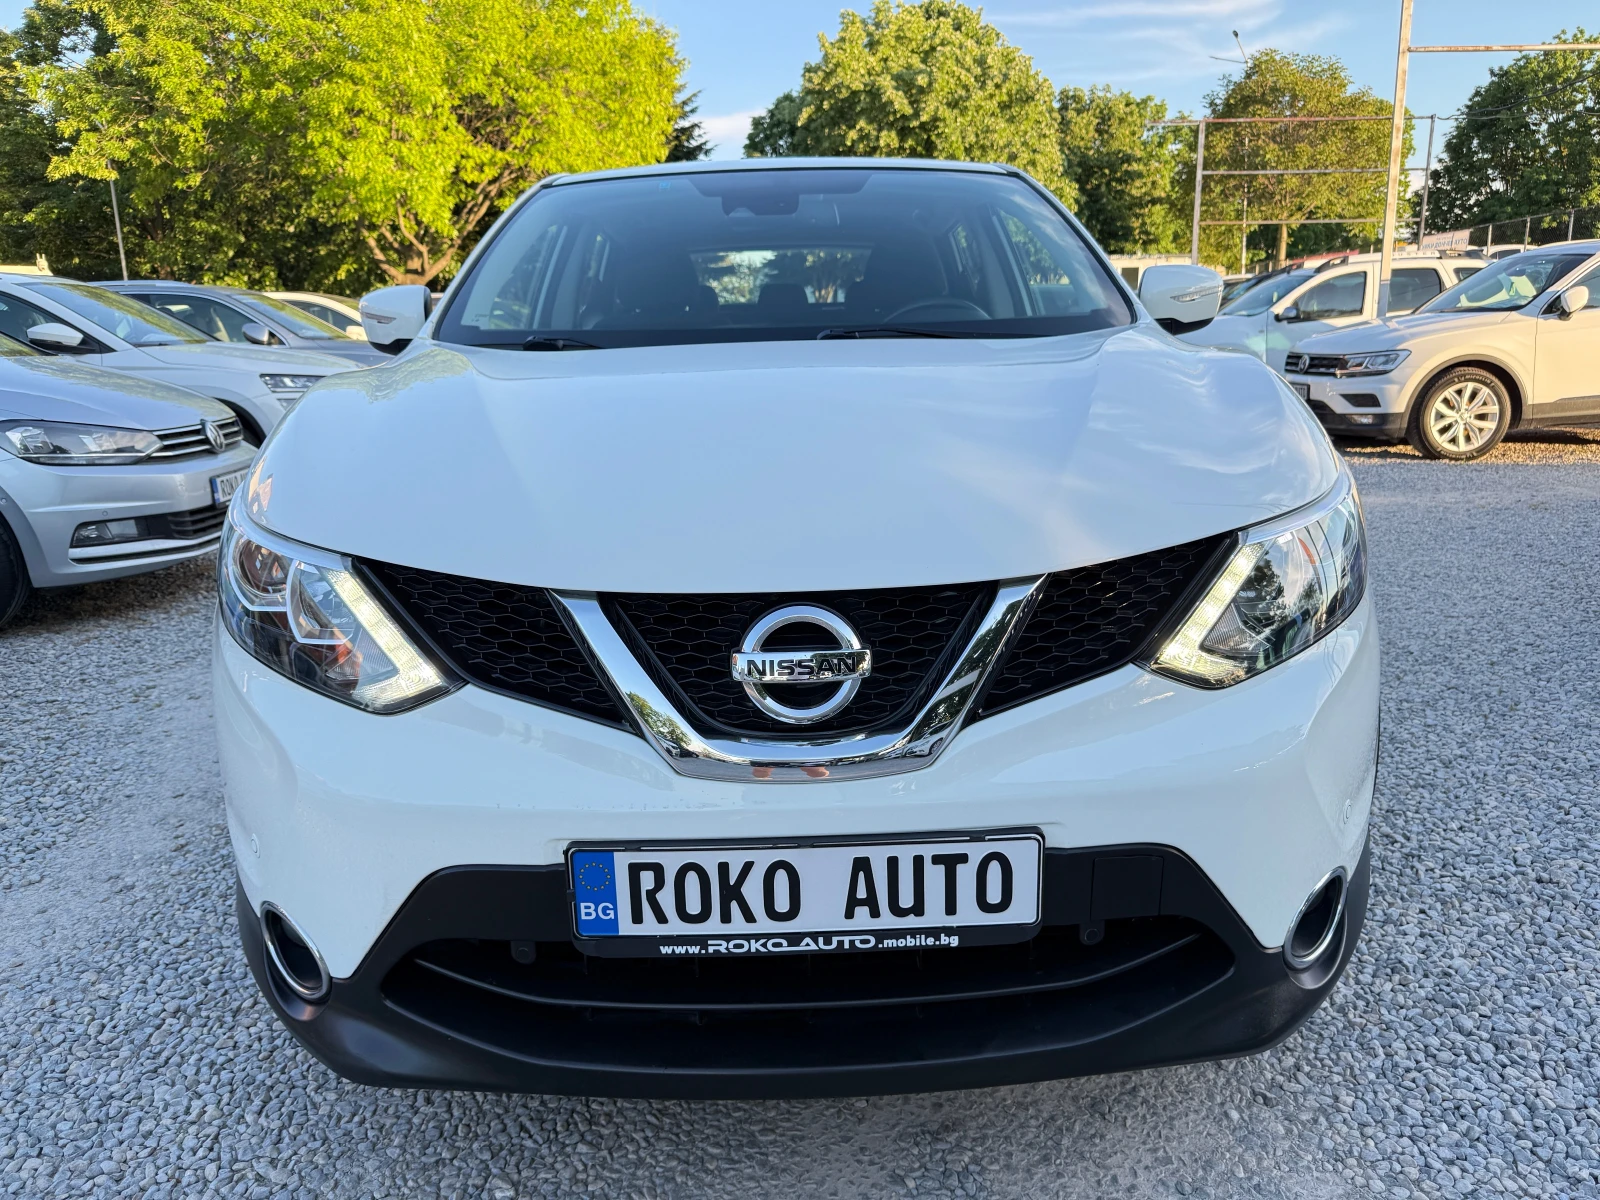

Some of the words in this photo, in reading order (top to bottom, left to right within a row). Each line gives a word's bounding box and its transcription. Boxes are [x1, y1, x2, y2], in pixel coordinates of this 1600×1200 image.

[746, 656, 857, 677] NISSAN
[627, 859, 802, 925] ROKO
[844, 851, 1014, 920] AUTO
[580, 902, 615, 920] BG
